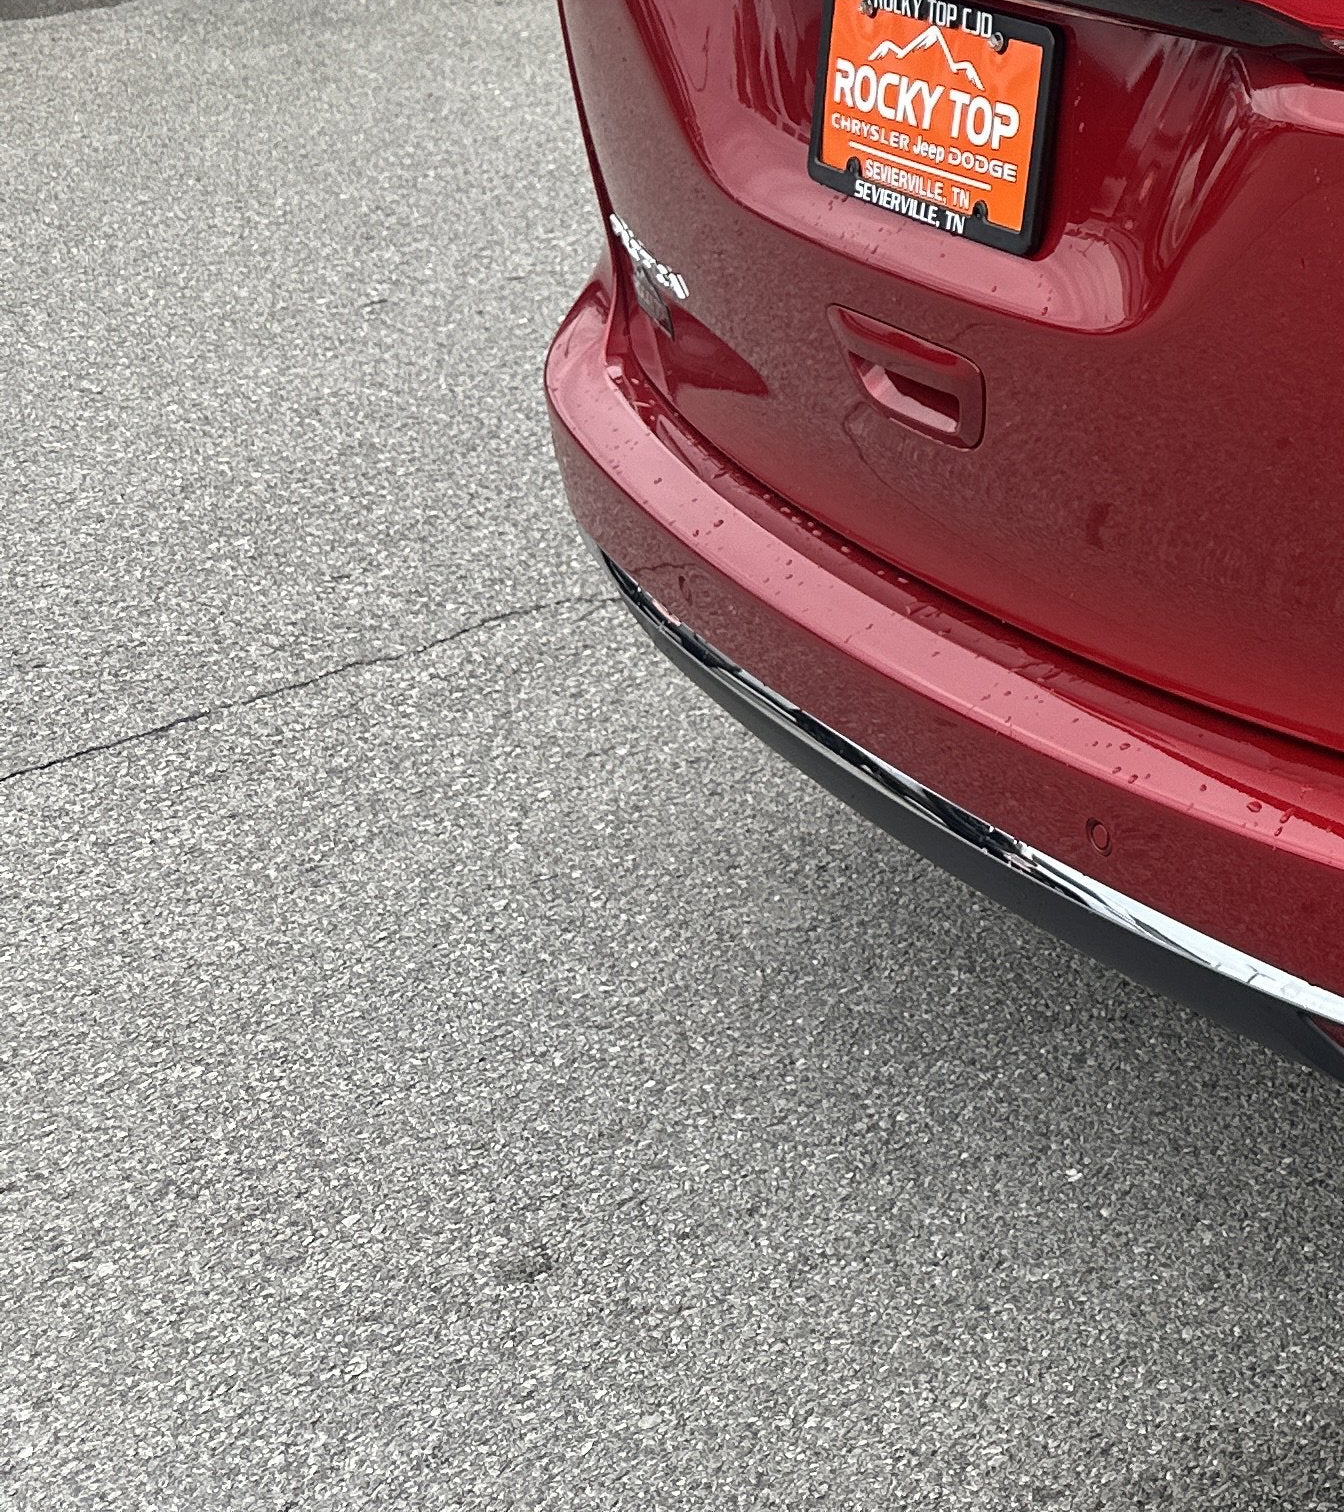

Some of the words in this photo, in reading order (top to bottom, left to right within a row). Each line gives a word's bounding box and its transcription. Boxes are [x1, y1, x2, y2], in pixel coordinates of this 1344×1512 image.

[961, 7, 993, 39] CJD
[833, 57, 946, 131] ROCKY
[948, 89, 1021, 151] TOP
[830, 112, 910, 151] CHRYSLER
[912, 135, 946, 164] Jeep
[948, 146, 1018, 183] DODGE
[854, 179, 941, 229] SEVIERVILLE,
[945, 211, 966, 235] TN
[864, 159, 948, 205] SEVIERVILLE,
[951, 188, 972, 210] TN
